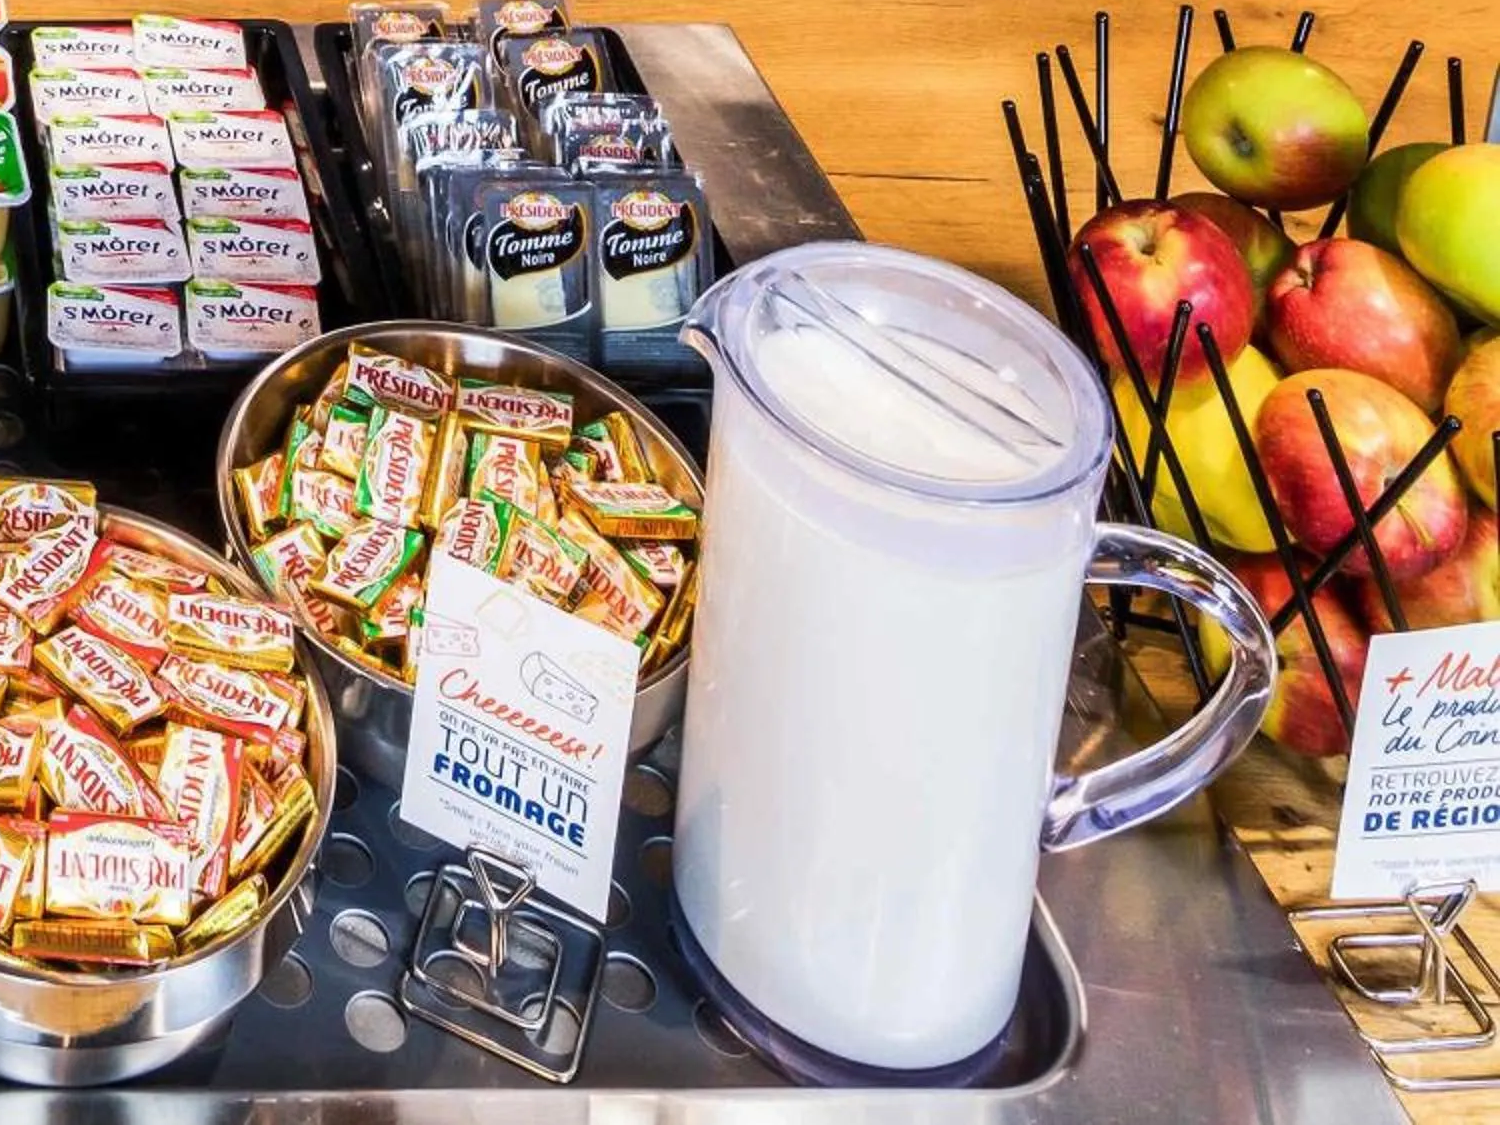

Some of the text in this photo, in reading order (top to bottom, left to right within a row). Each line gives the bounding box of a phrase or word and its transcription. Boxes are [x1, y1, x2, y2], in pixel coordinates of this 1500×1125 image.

[525, 72, 590, 104] Tomme
[500, 201, 580, 219] PRÉSIDENT
[612, 201, 682, 219] PRÉSIDENT
[495, 231, 573, 257] Tomme
[607, 230, 684, 257] Tomme
[521, 251, 556, 268] Noire
[633, 251, 667, 268] Noire
[356, 363, 454, 409] PRÉSIDENT
[464, 392, 570, 421] PRÉSIDENT
[6, 526, 90, 600] PRÉSIDENT
[179, 600, 292, 638] PRÉSIDENT
[61, 632, 150, 708] PRÉSIDENT
[164, 655, 277, 718] PRÉSIDENT
[1382, 693, 1412, 727] Le
[1384, 726, 1426, 755] du
[440, 724, 588, 824] TOUT UN
[1371, 764, 1498, 790] RETROUVEZ
[433, 753, 585, 848] FROMAGE
[1369, 788, 1433, 807] NOTRE
[1364, 811, 1401, 832] DE
[57, 850, 186, 890] PRÉSIDENT
